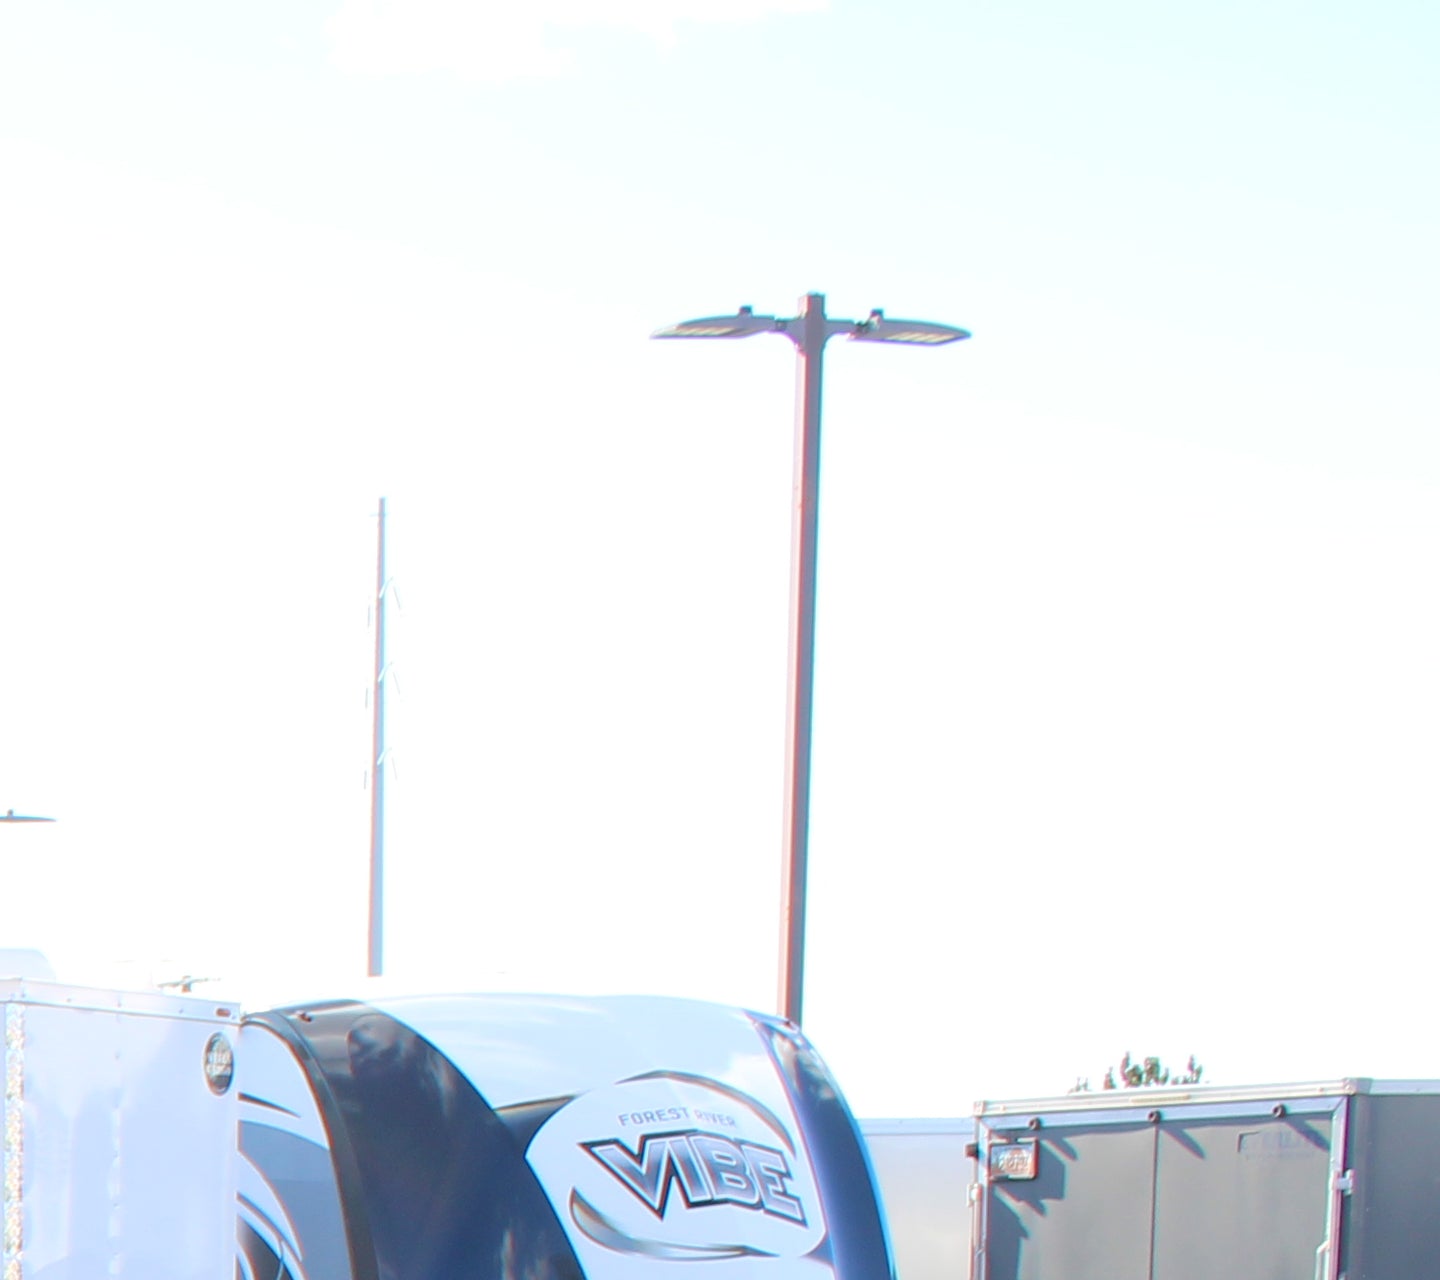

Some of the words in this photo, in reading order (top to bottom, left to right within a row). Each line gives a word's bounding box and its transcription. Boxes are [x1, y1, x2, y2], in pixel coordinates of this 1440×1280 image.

[617, 1107, 690, 1127] FOREST
[694, 1110, 737, 1127] RIVER
[577, 1130, 808, 1228] VIBE
